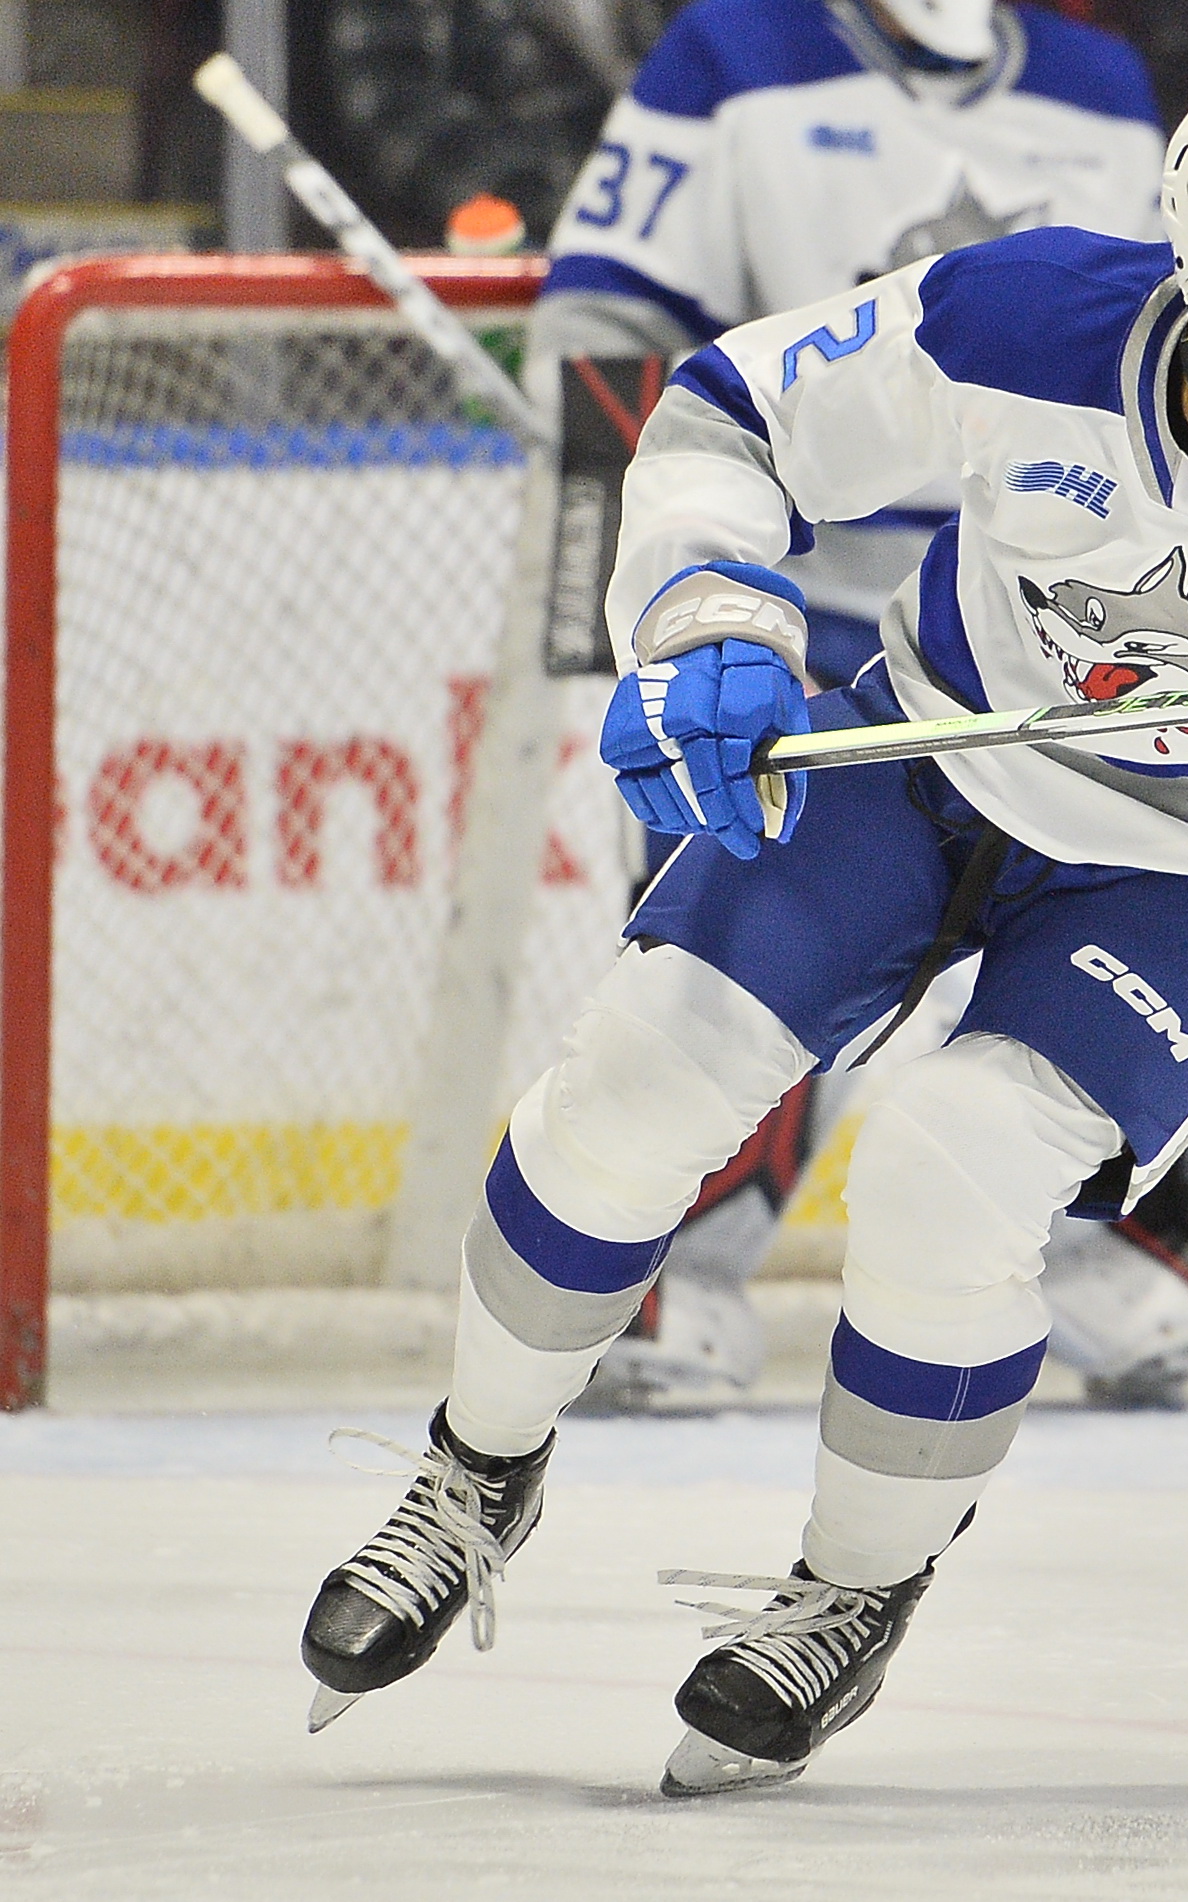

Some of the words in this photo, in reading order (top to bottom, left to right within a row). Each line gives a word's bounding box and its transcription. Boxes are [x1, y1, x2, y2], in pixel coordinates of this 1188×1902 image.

[574, 141, 691, 242] 37
[782, 298, 877, 394] 2
[1003, 459, 1118, 520] OHL
[652, 594, 805, 660] CCM
[821, 1685, 859, 1729] BAUER
